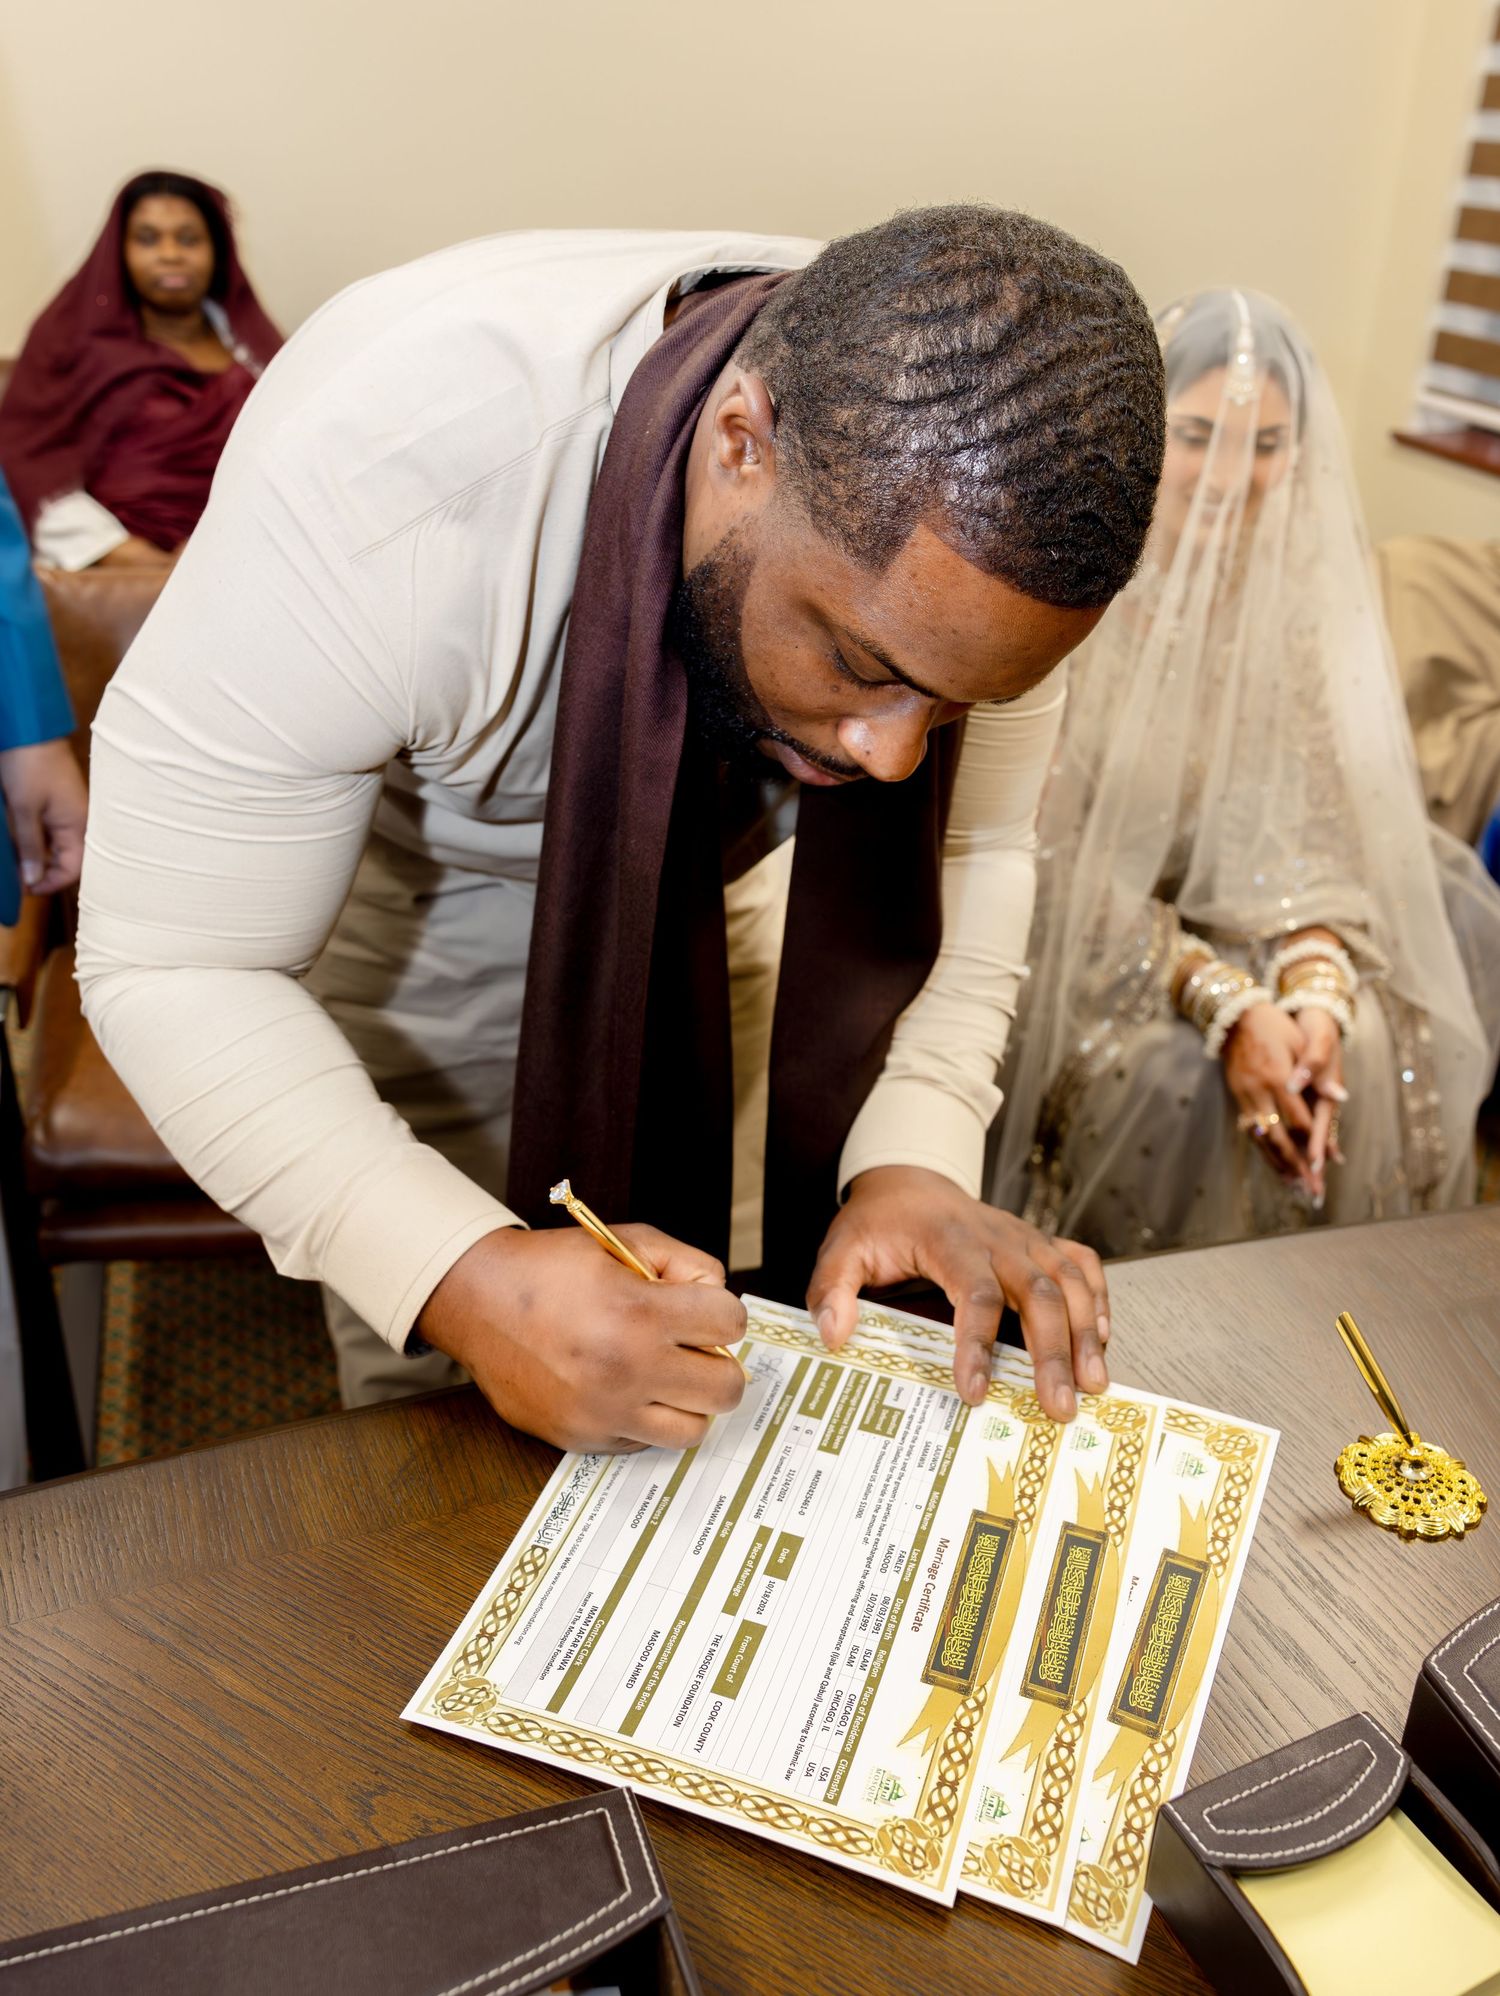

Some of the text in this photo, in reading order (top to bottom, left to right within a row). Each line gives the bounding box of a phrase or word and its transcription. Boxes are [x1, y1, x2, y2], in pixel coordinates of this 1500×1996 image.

[881, 1439, 890, 1450] One
[910, 1435, 919, 1444] the
[772, 1455, 787, 1476] Jumada
[872, 1450, 886, 1474] thousand
[900, 1461, 909, 1472] and
[916, 1440, 932, 1468] SAMAWIA
[928, 1444, 943, 1472] LAJUWON
[869, 1474, 876, 1482] US
[885, 1473, 893, 1483] the
[896, 1471, 905, 1481] the
[938, 1458, 950, 1476] Name
[774, 1468, 795, 1502] 11/14/2024
[861, 1482, 873, 1501] dollars
[879, 1482, 890, 1497] bride
[628, 1483, 659, 1529] AMIR MASOOD
[652, 1495, 670, 1520] Witness
[752, 1504, 764, 1519] 1446
[854, 1500, 866, 1520] $1000.
[873, 1503, 882, 1514] the
[880, 1503, 893, 1522] parties
[920, 1490, 939, 1531] Middle Name
[691, 1494, 727, 1555] SAMAWIA MASOOD
[719, 1520, 732, 1538] Bride
[865, 1513, 878, 1536] amount
[875, 1522, 886, 1537] have
[861, 1536, 870, 1545] of:
[862, 1536, 881, 1568] exchanged
[557, 1555, 570, 1571] Web:
[776, 1547, 790, 1564] Date
[878, 1543, 895, 1574] MASOOD
[892, 1549, 906, 1574] FARLEY
[902, 1547, 920, 1582] Last Name
[729, 1541, 762, 1597] Place of Marriage
[859, 1568, 869, 1579] the
[752, 1579, 776, 1615] 10/18/2024
[849, 1578, 865, 1603] offering
[910, 1536, 949, 1634] Marriage Certificate
[511, 1569, 562, 1645] www.mosquefoundation.org
[579, 1591, 594, 1607] Imam
[846, 1603, 856, 1616] and
[856, 1592, 877, 1631] 10/20/1992
[569, 1614, 580, 1625] The
[869, 1595, 890, 1635] 08/03/1991
[882, 1597, 903, 1640] Date of Birth
[554, 1624, 574, 1649] Mosque
[555, 1605, 599, 1671] IMAM JAFAR HAWA
[573, 1618, 604, 1666] Contract Clerk
[831, 1615, 851, 1651] acceptance
[537, 1648, 561, 1681] Foundation
[624, 1629, 660, 1689] MASOOD AHMED
[633, 1619, 686, 1711] Representative of the Bride
[724, 1635, 752, 1683] From Court of
[844, 1643, 859, 1667] ISLAM
[857, 1648, 872, 1671] ISLAM
[867, 1648, 886, 1678] Religion
[671, 1633, 723, 1728] THE MOSQUE FOUNDATION
[822, 1665, 832, 1680] and
[812, 1678, 827, 1702] Qabul)
[799, 1701, 819, 1734] according
[820, 1688, 843, 1733] CHICAGO, IL
[834, 1692, 856, 1737] CHICAGO, IL
[843, 1686, 873, 1753] Place of Residence
[691, 1699, 723, 1753] COOK COUNTY
[798, 1734, 807, 1743] to
[789, 1743, 804, 1767] Islamic
[783, 1766, 795, 1781] law
[803, 1761, 816, 1778] USA
[817, 1765, 830, 1783] USA
[824, 1757, 847, 1801] Citizenship
